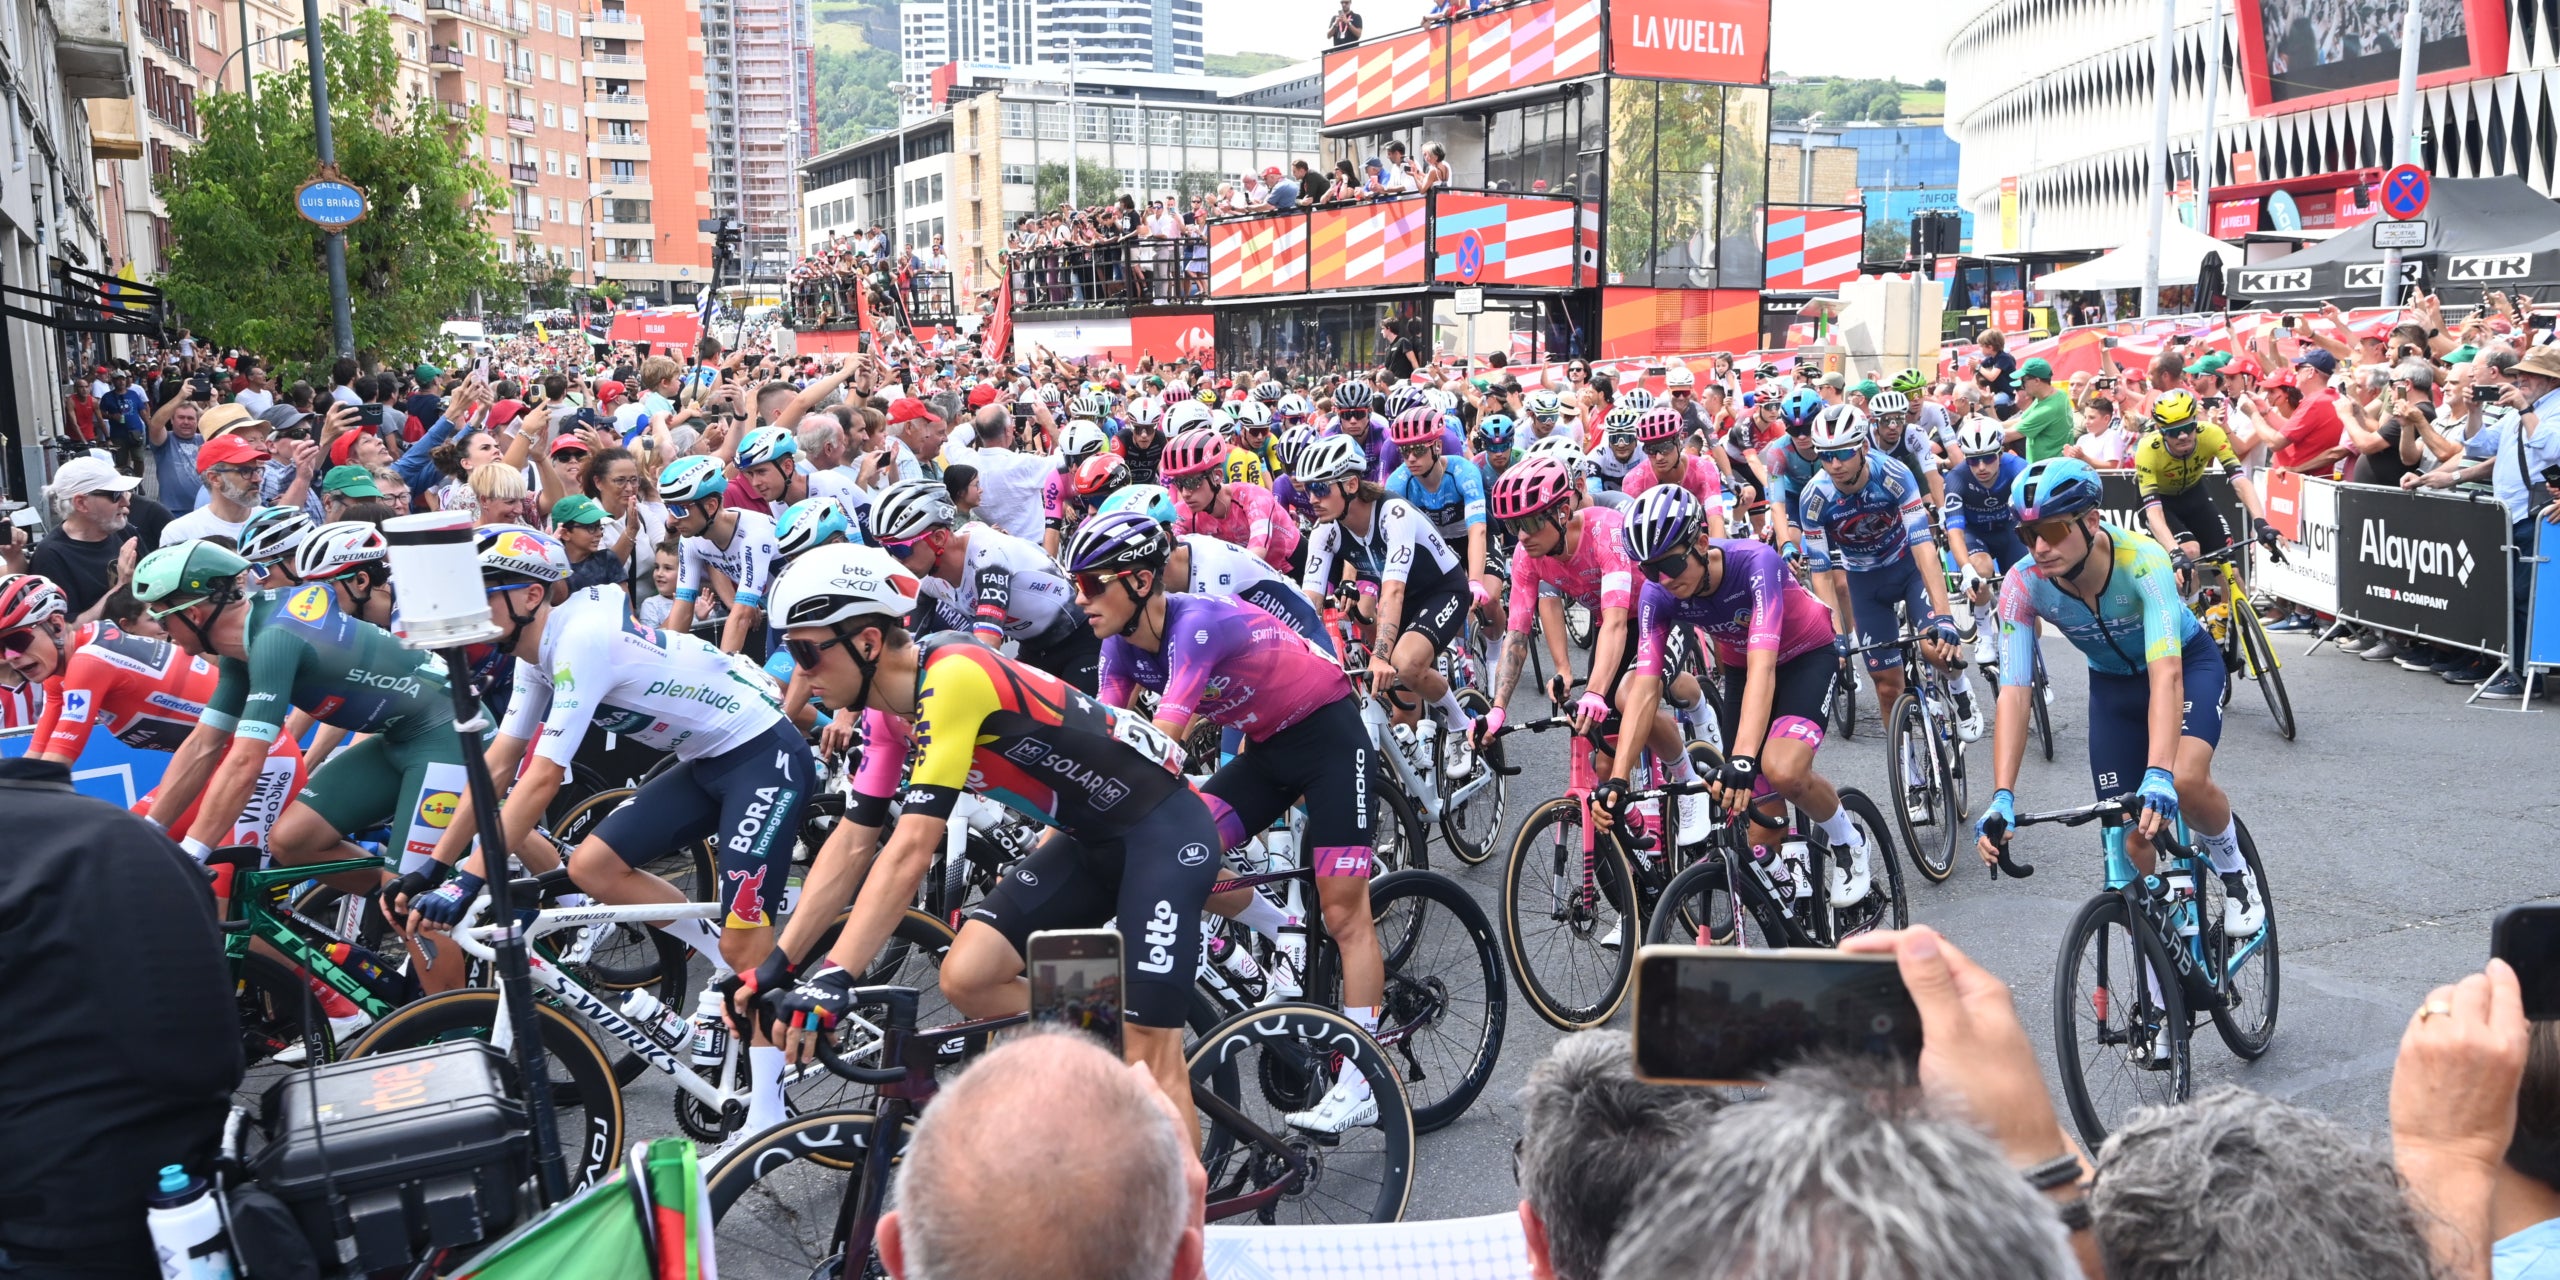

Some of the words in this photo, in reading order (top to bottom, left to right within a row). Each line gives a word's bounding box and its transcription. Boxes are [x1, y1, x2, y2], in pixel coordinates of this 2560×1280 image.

[1632, 14, 1660, 49] LA
[1664, 17, 1745, 56] VUELTA
[301, 198, 324, 207] LUIS
[326, 196, 360, 208] BRIÑAS
[315, 182, 343, 191] CALLE
[319, 215, 346, 223] KALEA
[2220, 216, 2230, 229] LA
[2229, 214, 2251, 229] VUELTA
[1832, 508, 1858, 519] Ekopak
[259, 540, 286, 556] RUDY
[332, 549, 387, 563] SPECIALIZED
[2359, 518, 2454, 584] Alayan
[485, 554, 559, 580] SPECIALIZED
[1249, 590, 1304, 634] BAHRAIN
[1755, 590, 1764, 626] CORTIZO
[2003, 587, 2017, 620] FREEDOM
[2365, 584, 2373, 596] A
[2402, 591, 2449, 611] COMPANY
[1642, 604, 1651, 639] CORTIZO
[2160, 608, 2176, 651] ASTANA
[104, 653, 146, 673] VINGEGAARD
[643, 678, 741, 715] plenitude
[1788, 723, 1821, 745] BH
[1041, 753, 1102, 794] SOLAR
[1357, 747, 1367, 830] SIROKO
[728, 786, 780, 854] BORA
[751, 791, 793, 856] hansgrohe
[1335, 857, 1368, 869] BH
[553, 911, 617, 924] SPECIALIZED
[273, 928, 390, 1017] TREK
[546, 976, 685, 1075] S-WORKS
[713, 1029, 722, 1055] GARM
[1332, 1102, 1377, 1133] SPECIALIZED
